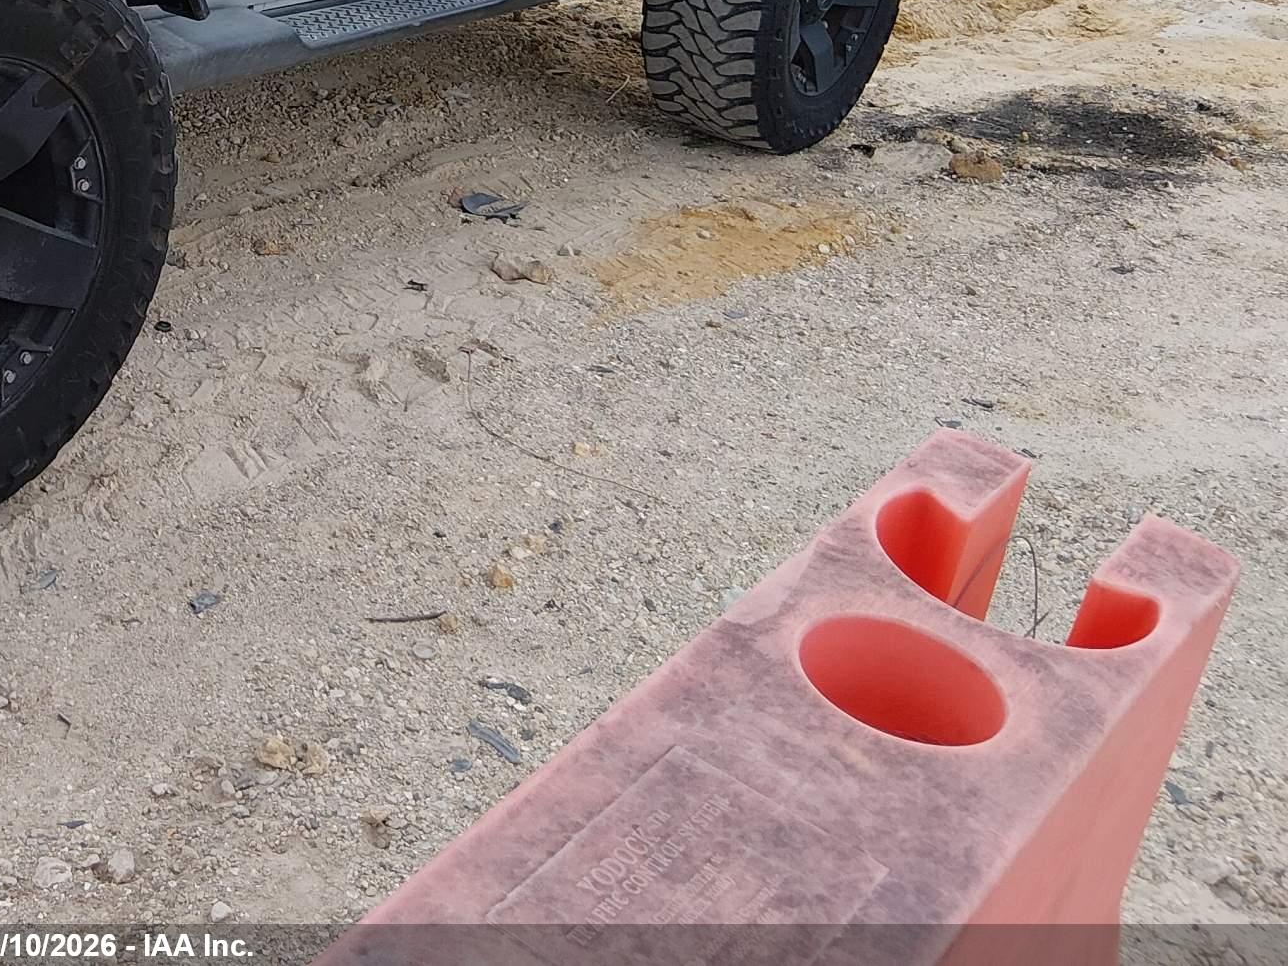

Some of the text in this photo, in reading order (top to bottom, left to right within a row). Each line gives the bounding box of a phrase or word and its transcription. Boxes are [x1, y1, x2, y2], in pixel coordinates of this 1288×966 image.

[566, 890, 630, 947] TRAFFIC
[622, 839, 686, 896] CONTROL
[679, 794, 731, 842] SYSTEM
[576, 828, 661, 897] YODOCK
